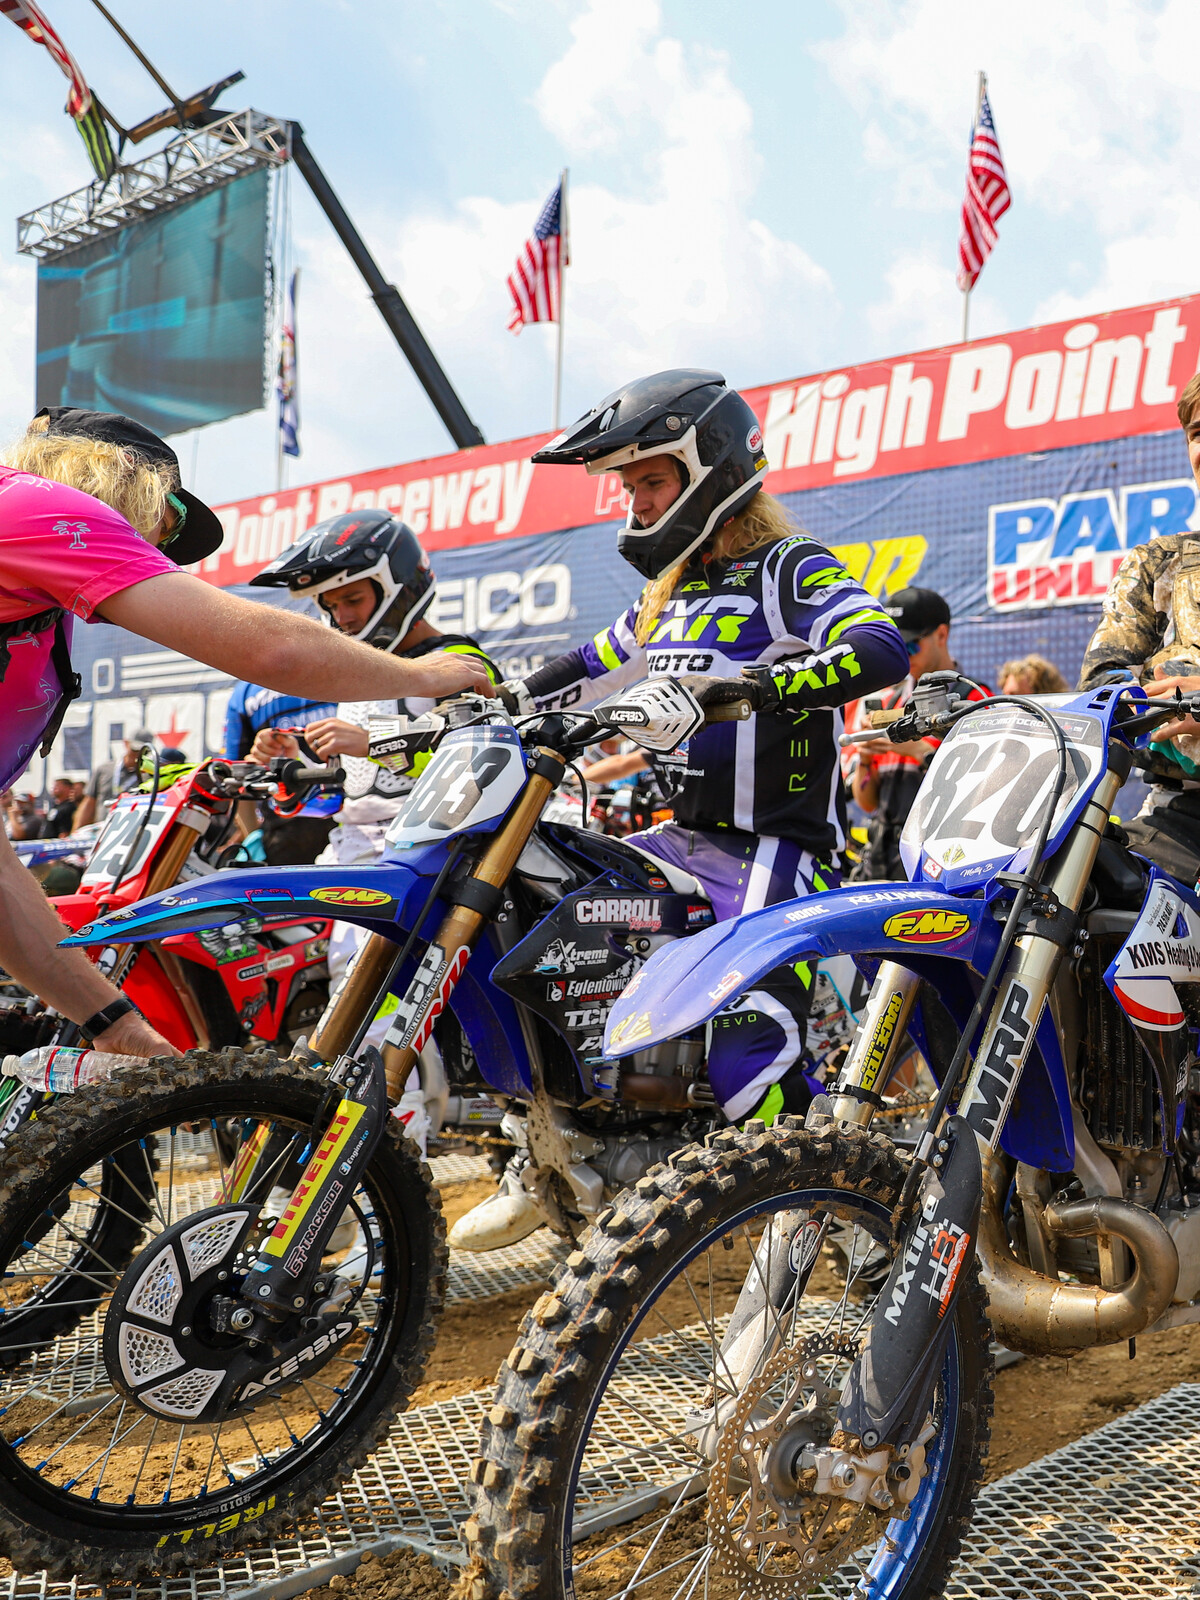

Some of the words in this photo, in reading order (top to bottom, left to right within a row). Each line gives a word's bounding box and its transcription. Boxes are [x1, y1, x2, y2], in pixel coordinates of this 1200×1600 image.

[765, 363, 934, 477] High
[938, 307, 1188, 442] Point
[426, 563, 571, 631] EICO
[609, 710, 645, 723] ACERBIS
[370, 739, 409, 757] ACERBIS
[918, 739, 1092, 847] 820
[314, 889, 388, 904] FMF
[576, 899, 662, 923] CARROLL
[628, 916, 662, 932] Racing
[885, 912, 968, 937] FMF
[1126, 942, 1166, 970] KMS
[860, 1048, 885, 1091] TEC
[965, 981, 1032, 1146] MRP
[299, 1180, 344, 1254] TRACKSIDE
[884, 1194, 939, 1327] MXtire
[239, 1321, 353, 1402] ACERBIS
[156, 1492, 290, 1548] IRELLI
